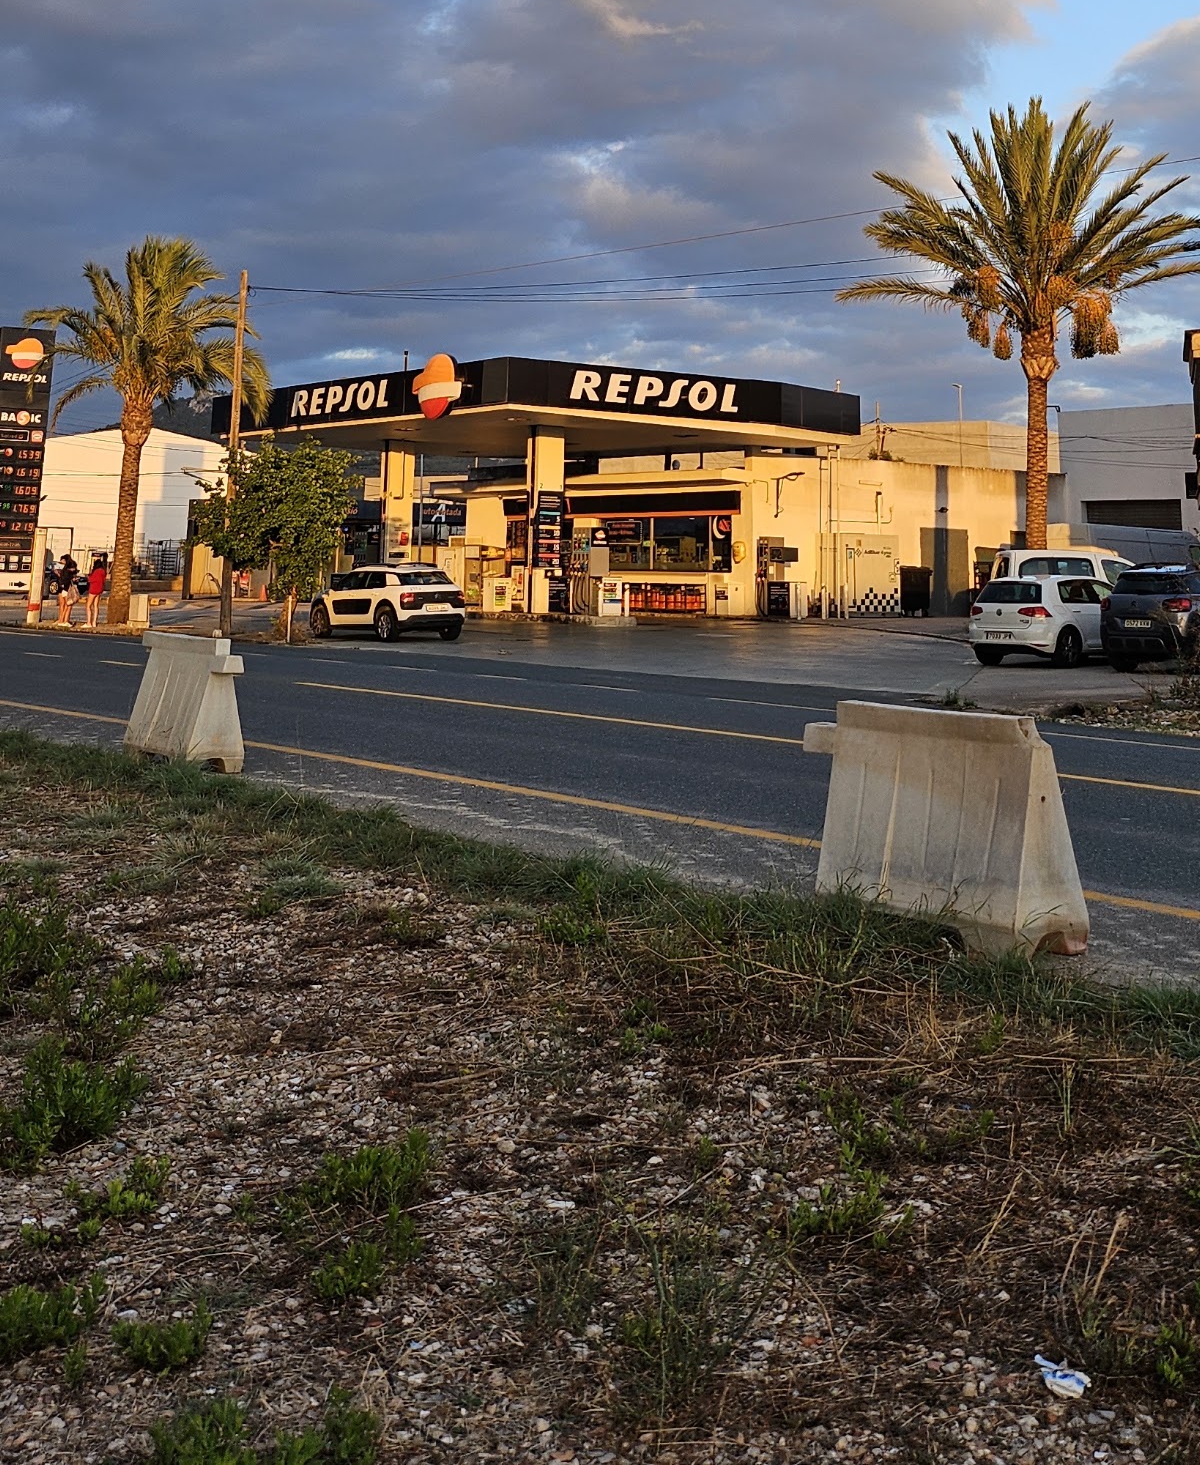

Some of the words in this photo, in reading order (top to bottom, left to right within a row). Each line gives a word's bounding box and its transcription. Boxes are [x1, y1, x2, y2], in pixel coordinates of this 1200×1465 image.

[3, 372, 48, 384] REPSOL
[291, 379, 388, 418] REPSOL
[569, 370, 739, 413] REPSOL
[1, 411, 42, 425] BASIC
